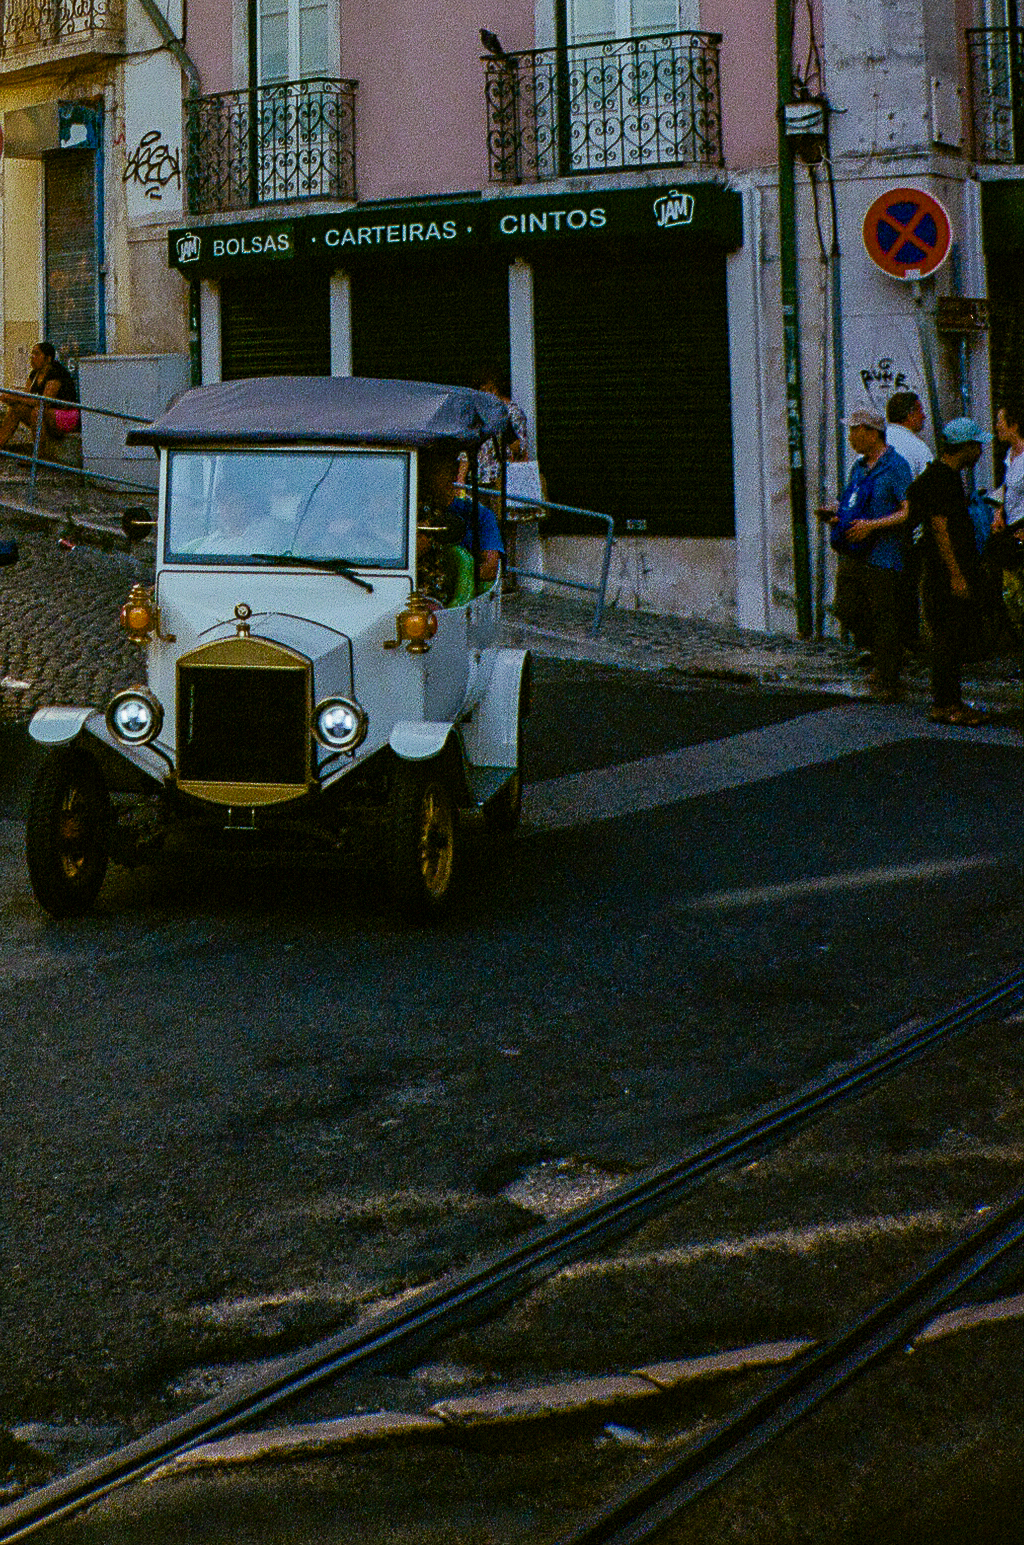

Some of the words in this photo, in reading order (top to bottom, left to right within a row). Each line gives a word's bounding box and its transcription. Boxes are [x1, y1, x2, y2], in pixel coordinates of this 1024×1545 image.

[212, 233, 290, 257] BOLSAS
[324, 220, 458, 247] CARTEIRAS
[499, 208, 608, 235] CINTOS
[656, 194, 689, 227] JAM
